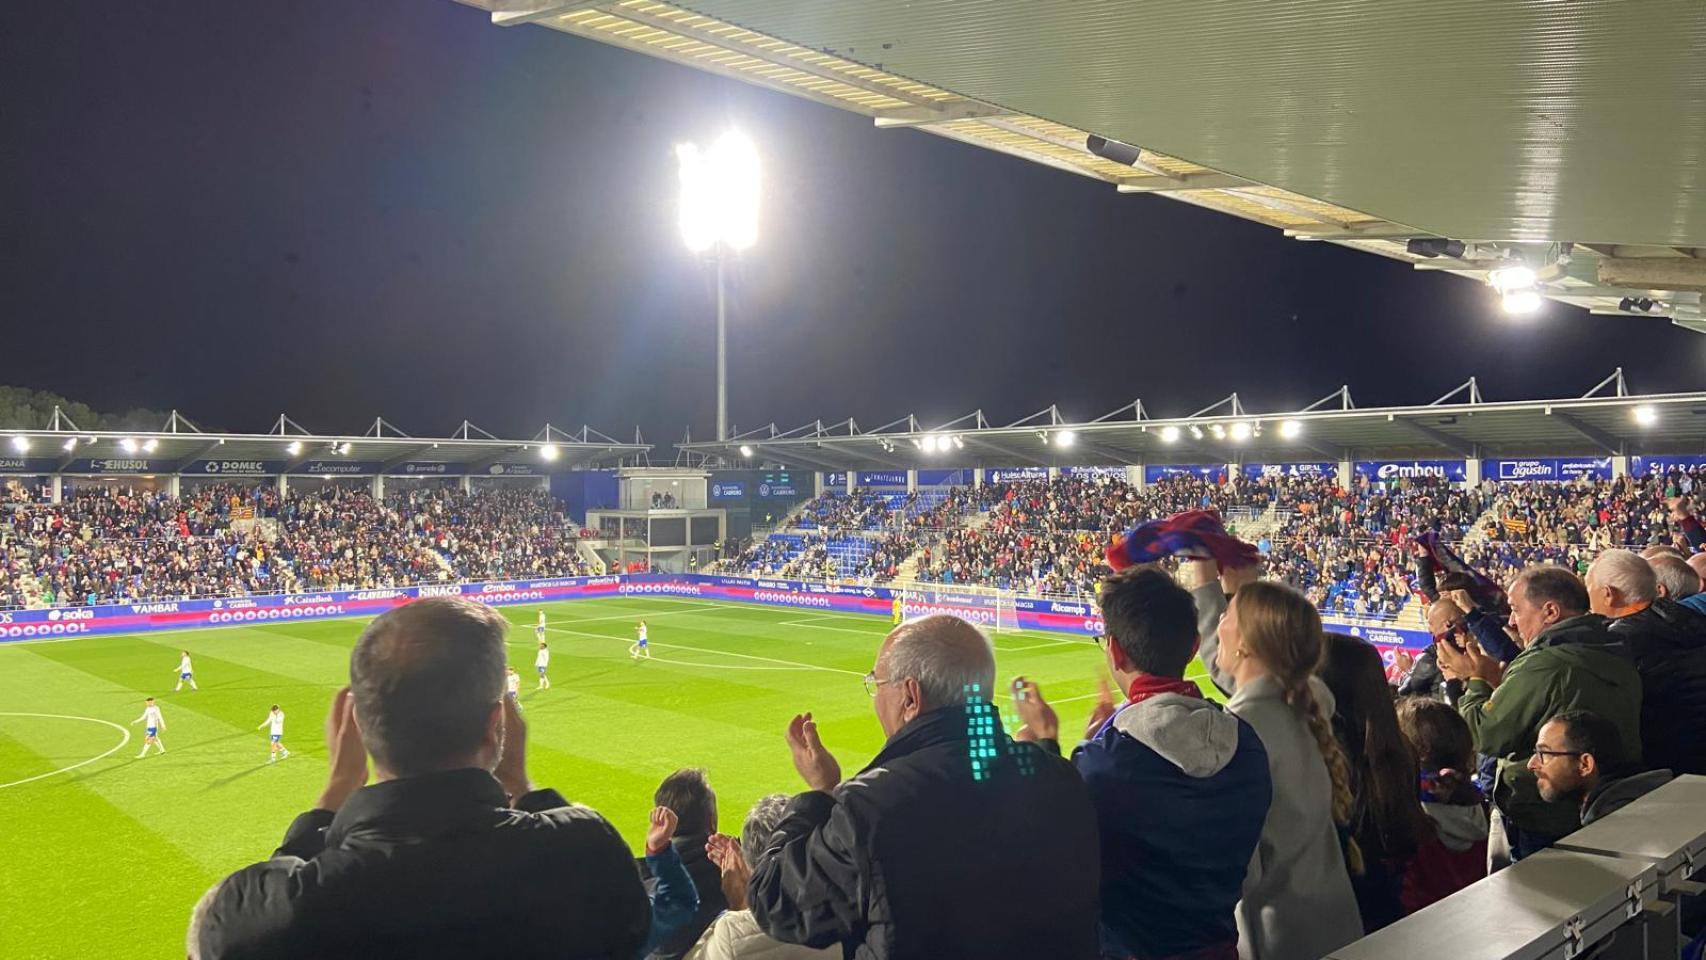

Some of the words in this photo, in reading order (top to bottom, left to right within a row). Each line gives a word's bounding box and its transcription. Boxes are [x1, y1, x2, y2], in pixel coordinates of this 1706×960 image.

[221, 461, 263, 470] DOMEC
[295, 595, 333, 605] CaixaBank
[140, 603, 180, 614] AMBAR
[1369, 635, 1404, 645] CABRERO
